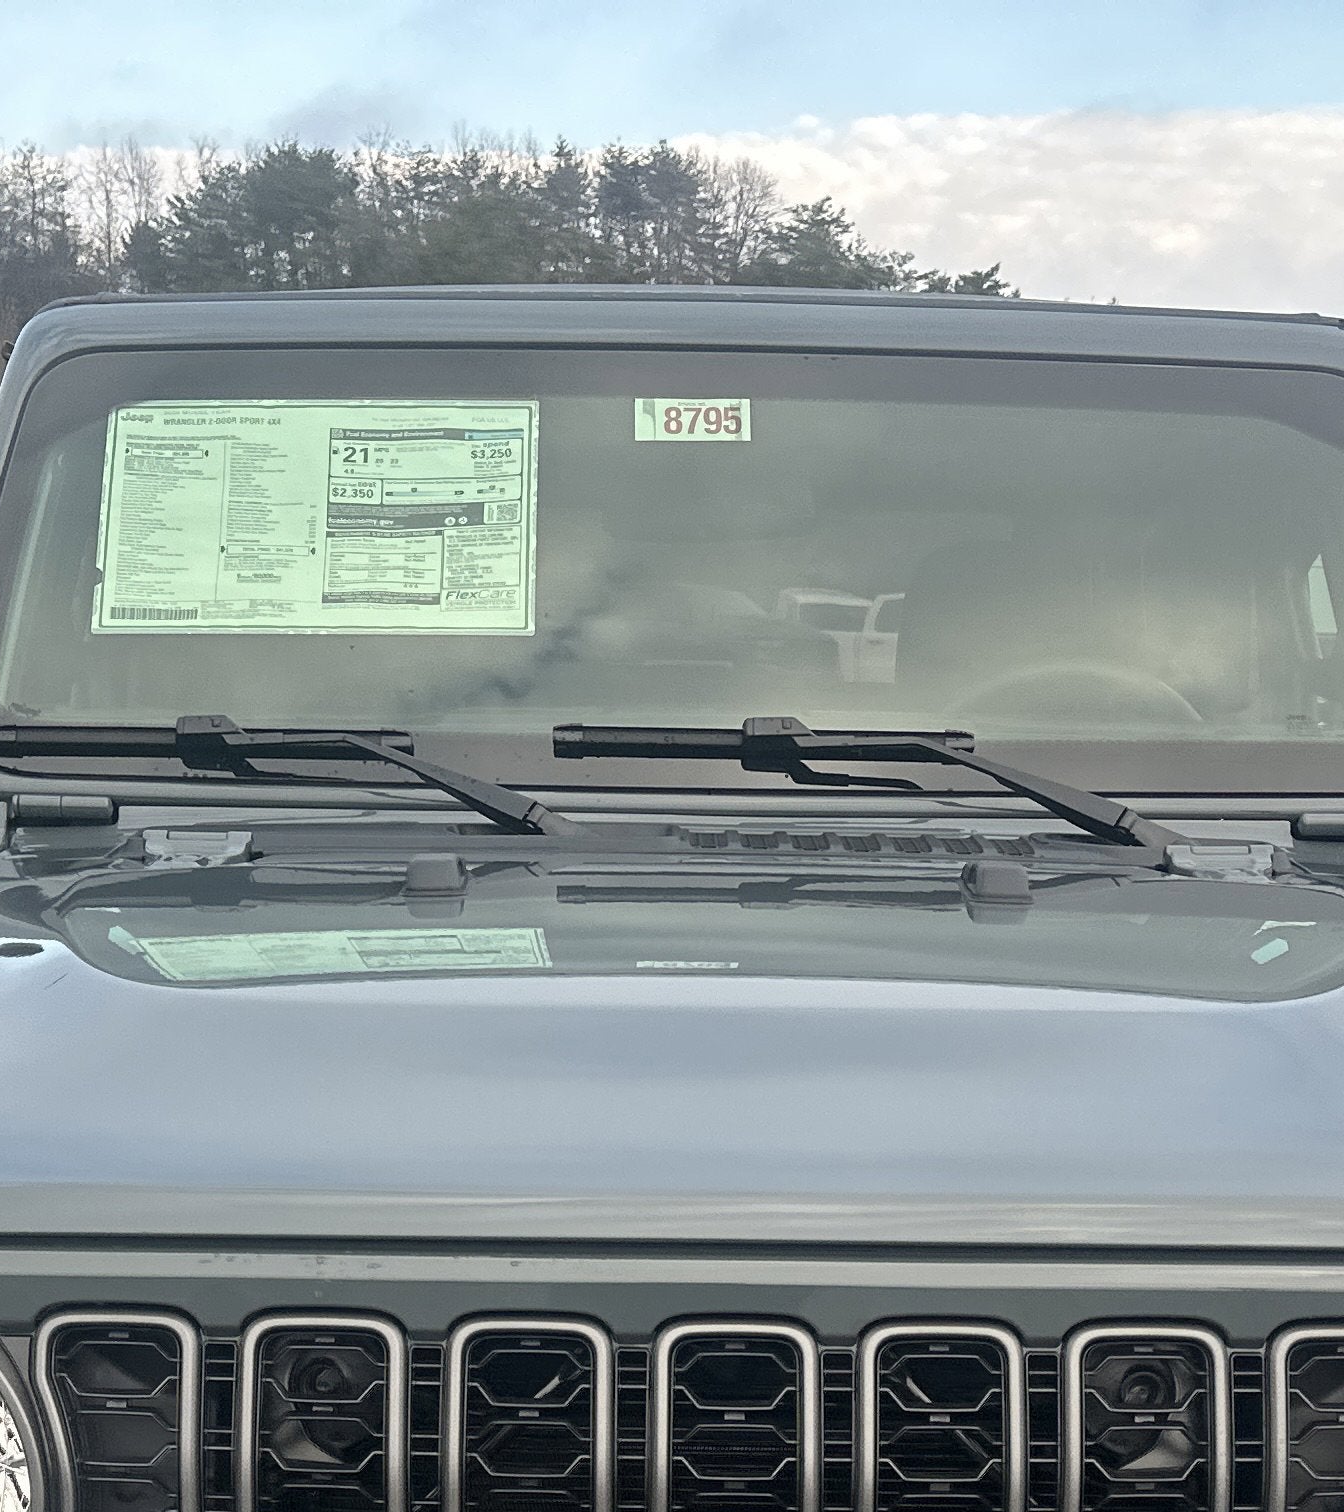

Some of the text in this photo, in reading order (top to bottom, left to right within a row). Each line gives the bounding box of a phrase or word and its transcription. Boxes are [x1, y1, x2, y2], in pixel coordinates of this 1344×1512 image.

[120, 412, 154, 424] Jeep
[163, 417, 281, 426] WRANGLER 2-DOOR SPORT 4X4
[664, 406, 742, 435] 8795
[342, 446, 369, 464] 21
[470, 448, 513, 460] $3,250
[331, 487, 374, 499] $2,350
[445, 589, 517, 600] FlexCare
